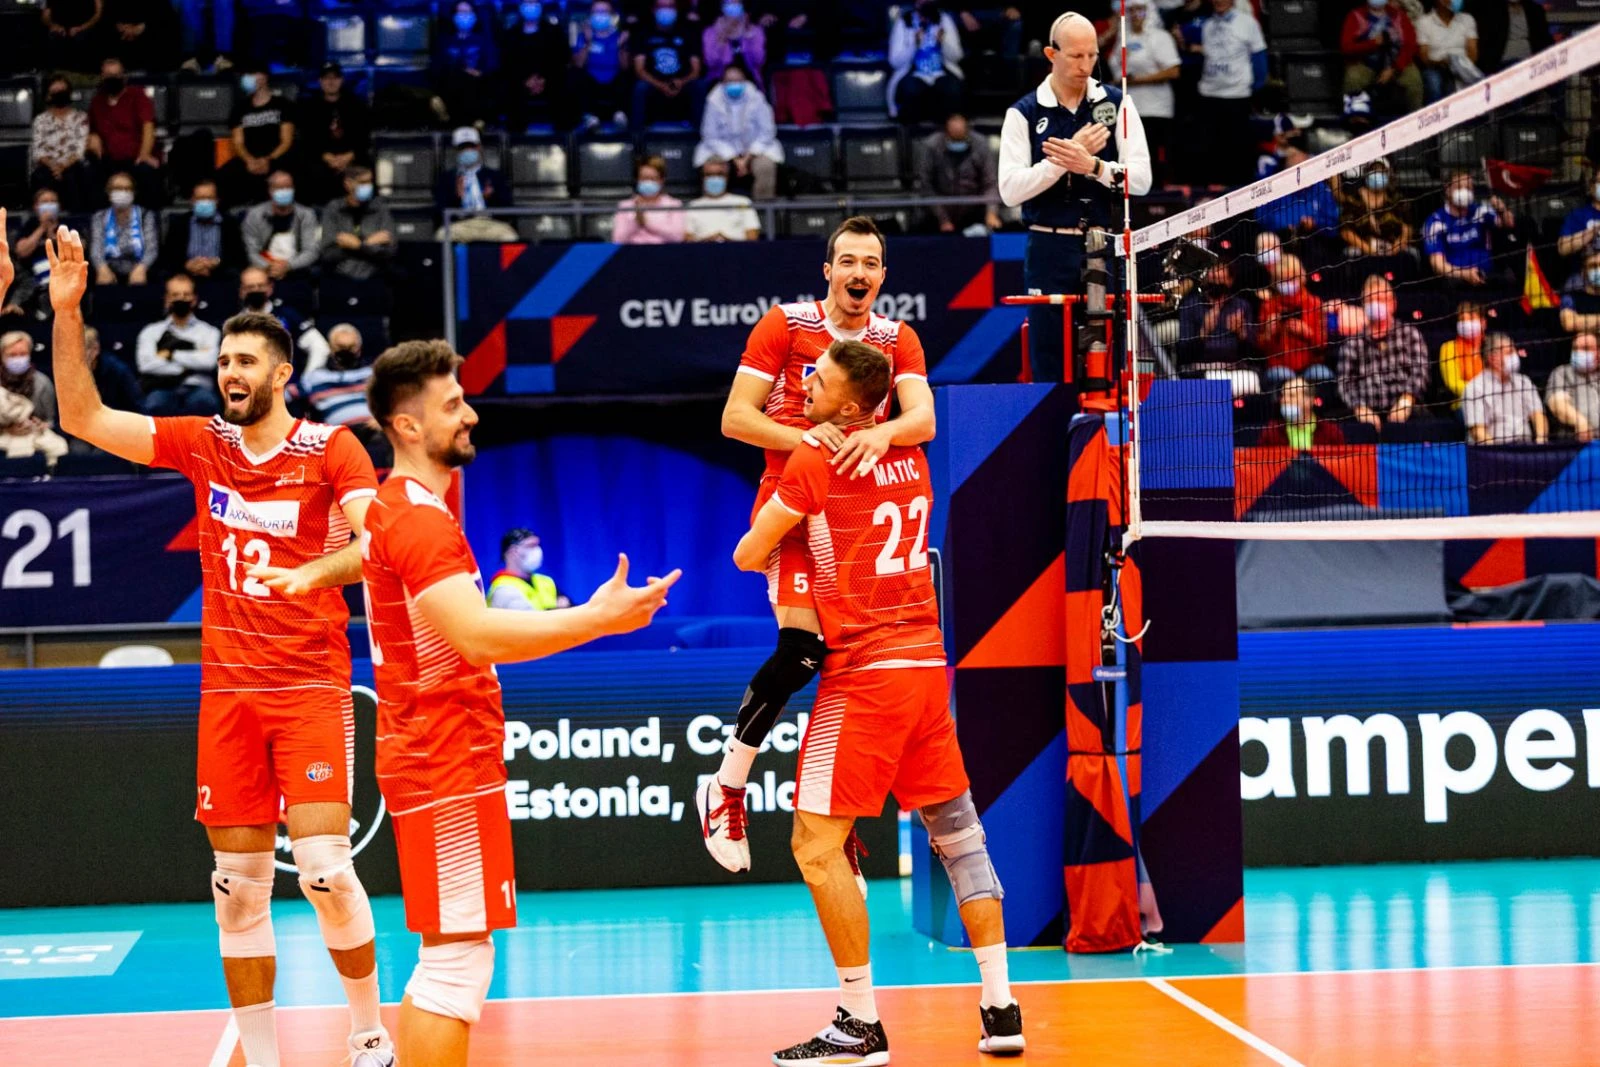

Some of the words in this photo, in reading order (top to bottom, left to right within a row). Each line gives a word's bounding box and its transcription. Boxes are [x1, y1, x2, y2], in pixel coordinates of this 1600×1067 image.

[619, 298, 685, 328] CEV
[691, 294, 815, 327] EuroV
[871, 292, 927, 320] 021
[872, 457, 920, 487] MATIC
[1, 508, 92, 589] 21
[872, 495, 929, 576] 22
[221, 532, 271, 597] 12
[793, 572, 809, 594] 5
[503, 717, 675, 763] Poland,
[506, 775, 685, 821] Estonia,
[501, 879, 517, 909] 1
